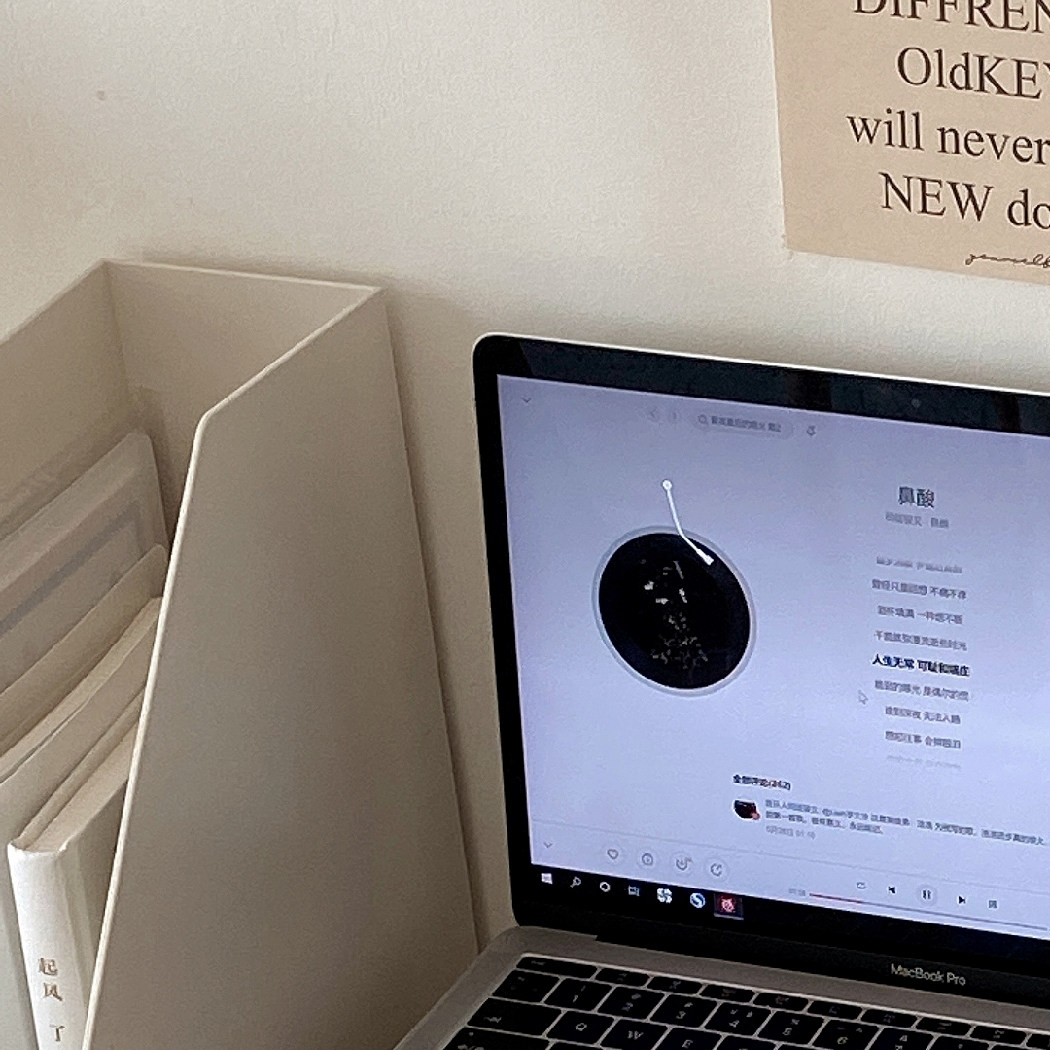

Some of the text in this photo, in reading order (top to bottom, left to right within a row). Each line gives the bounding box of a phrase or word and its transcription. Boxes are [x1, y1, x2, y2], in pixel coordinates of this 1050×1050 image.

[846, 107, 924, 151] will
[879, 171, 993, 222] NEW
[891, 963, 966, 986] MacBook Pro
